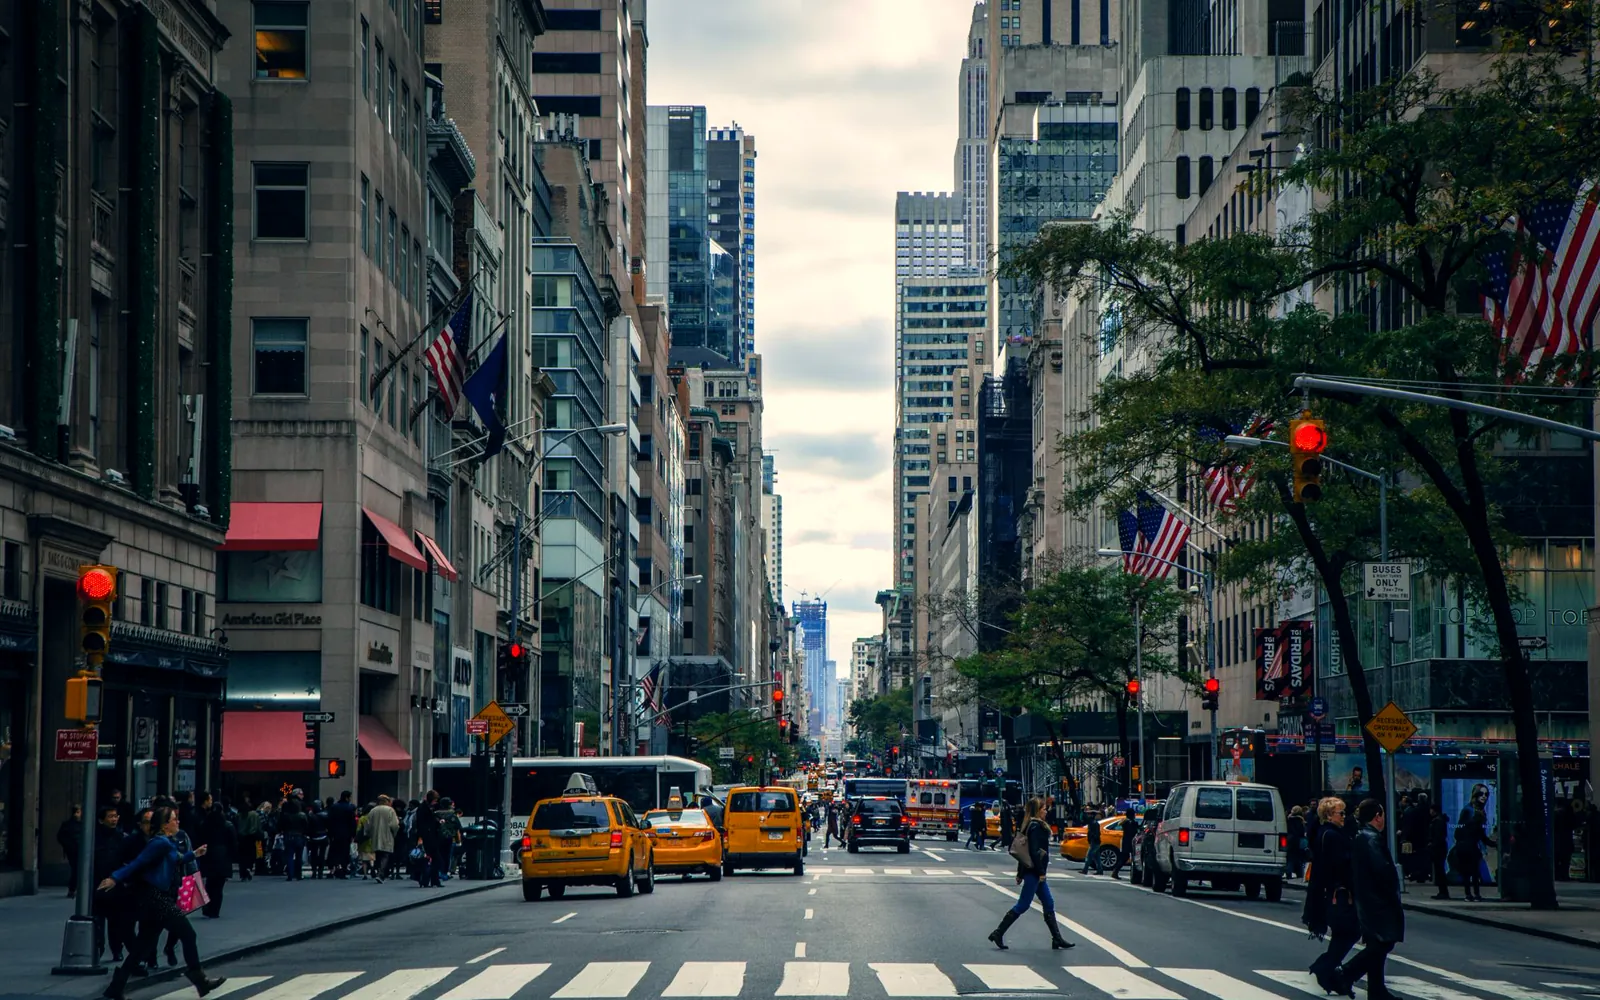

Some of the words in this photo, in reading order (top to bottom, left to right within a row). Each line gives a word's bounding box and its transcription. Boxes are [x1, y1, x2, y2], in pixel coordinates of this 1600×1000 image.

[1372, 565, 1401, 574] BUSES
[1375, 578, 1398, 587] ONLY
[222, 612, 272, 625] American
[273, 612, 294, 625] Girl
[294, 612, 322, 625] Place
[1435, 608, 1537, 626] TOPSOP
[1290, 636, 1302, 688] FRIDAYS
[454, 656, 472, 687] ALDO
[1264, 643, 1275, 692] FRIDYS
[1376, 717, 1408, 725] RECESSED
[1373, 724, 1409, 732] CROSSWALK
[59, 732, 68, 740] NO
[69, 732, 96, 740] STOPPING
[63, 740, 91, 748] ANYTIME
